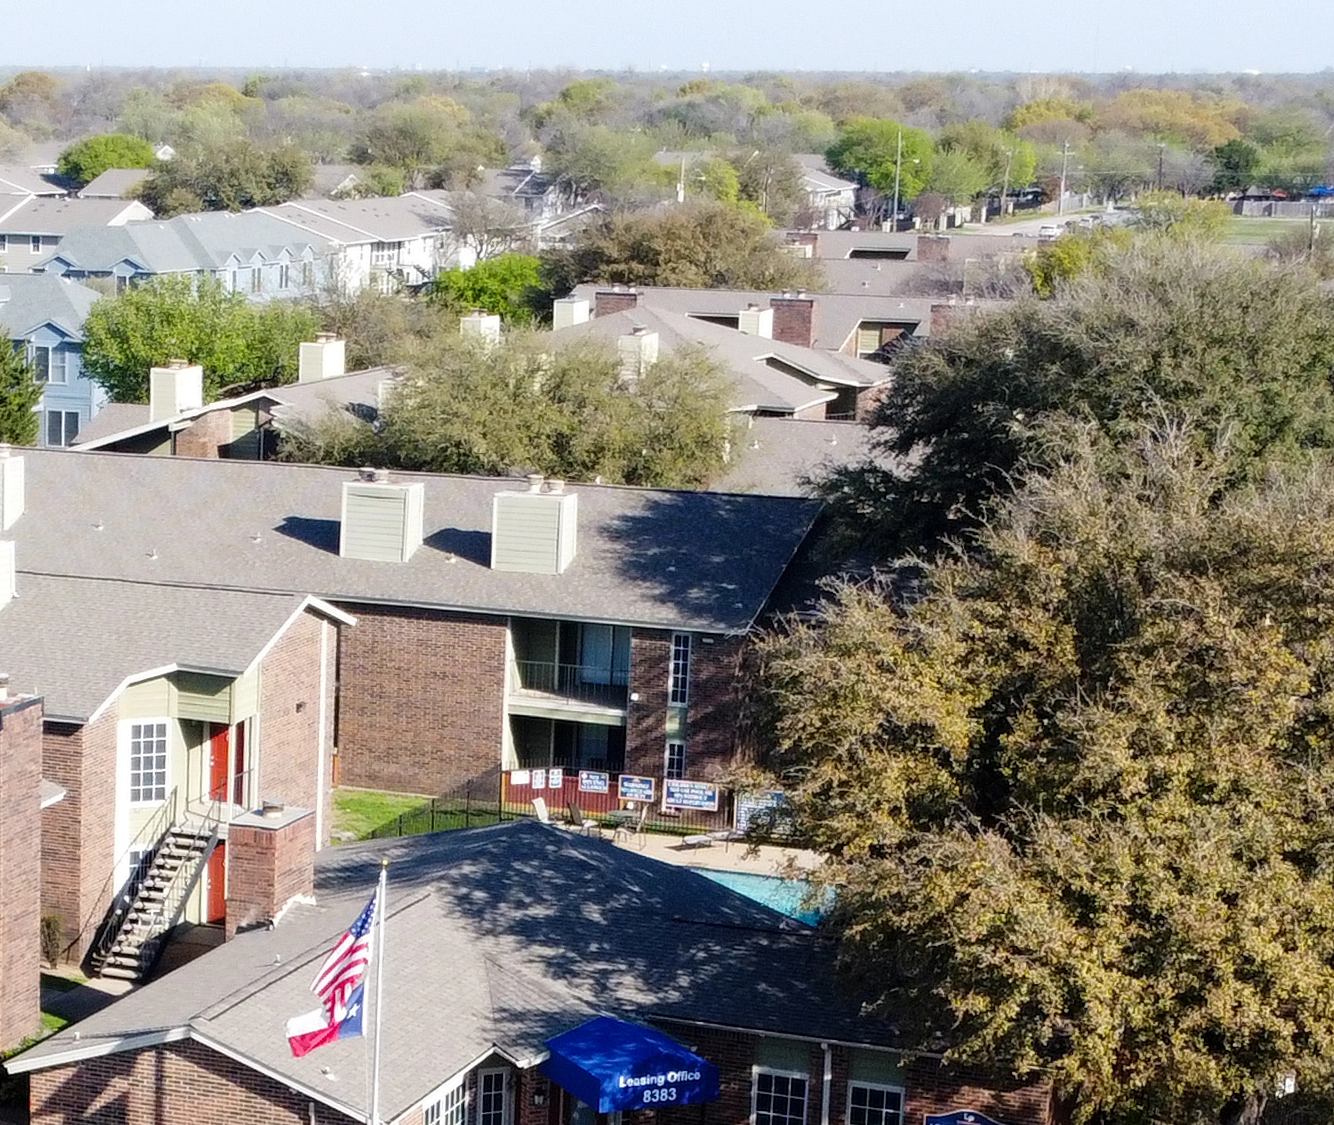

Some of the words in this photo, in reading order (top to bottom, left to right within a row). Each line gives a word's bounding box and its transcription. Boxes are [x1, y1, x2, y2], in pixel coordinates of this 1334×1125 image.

[619, 1074, 665, 1088] Leasing
[667, 1070, 701, 1083] Office
[643, 1087, 677, 1103] 8383
